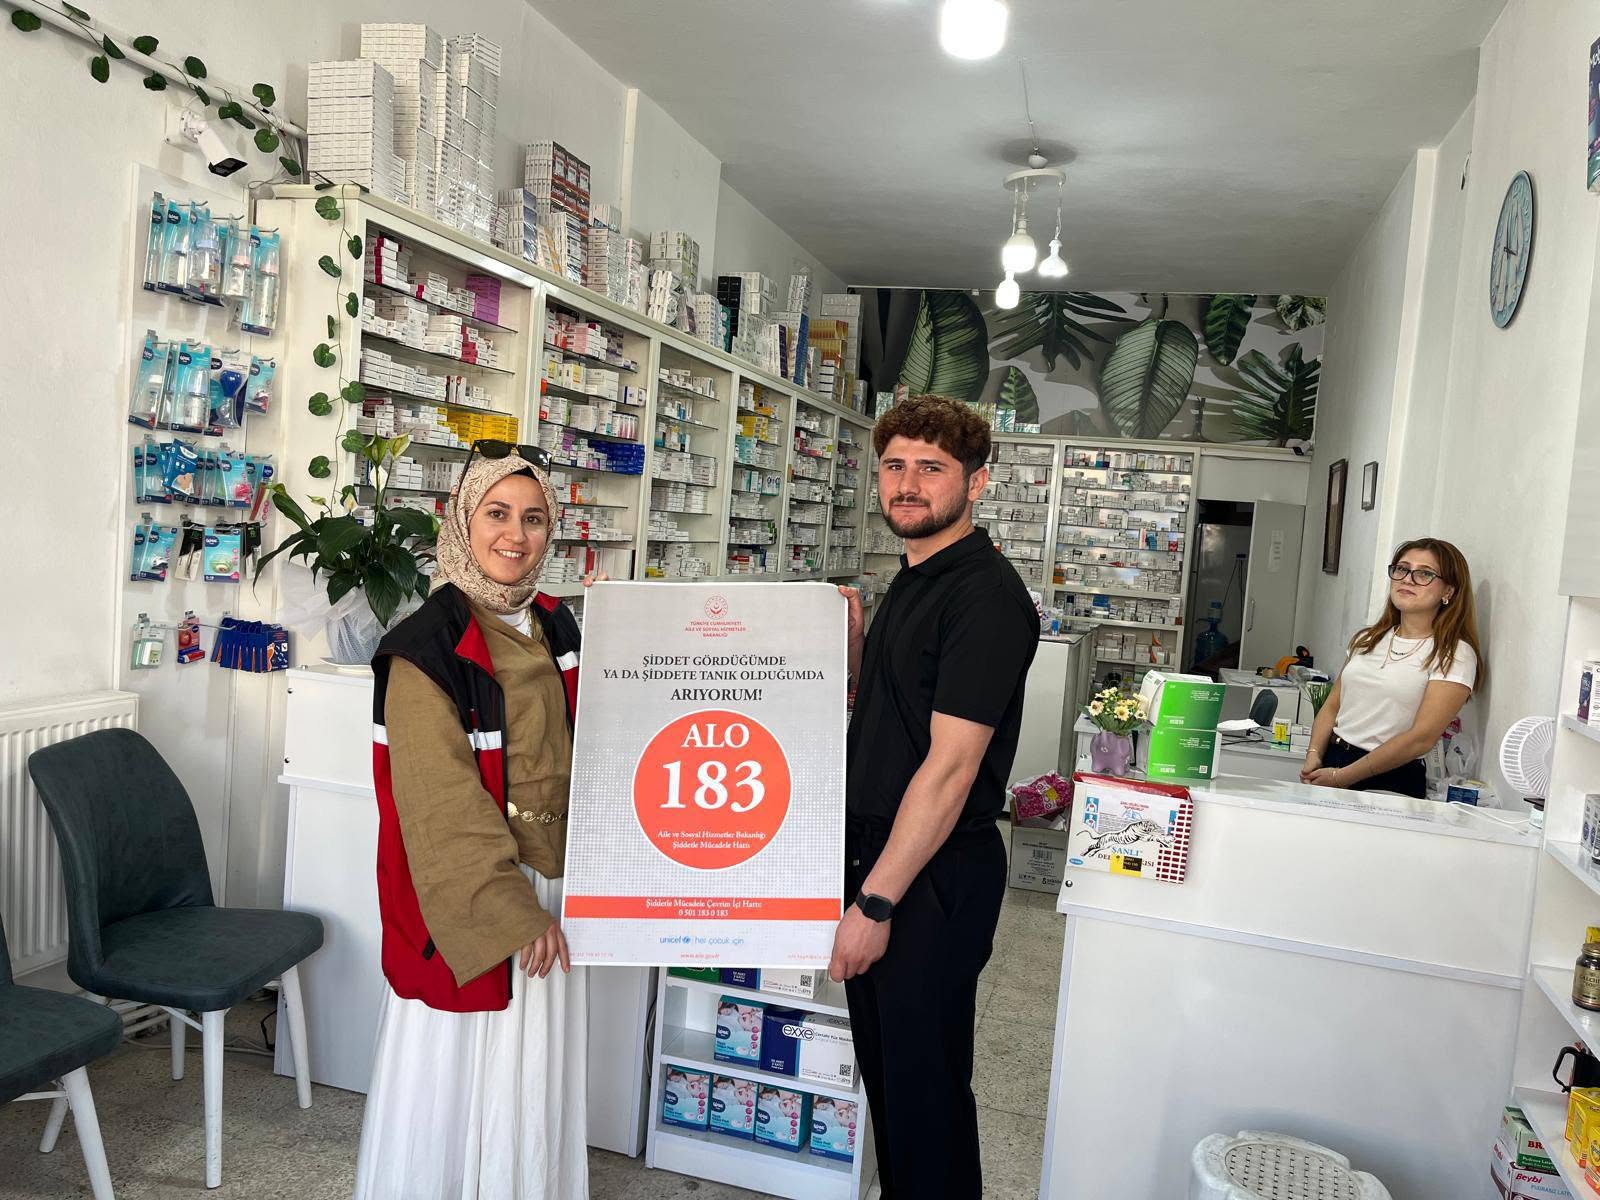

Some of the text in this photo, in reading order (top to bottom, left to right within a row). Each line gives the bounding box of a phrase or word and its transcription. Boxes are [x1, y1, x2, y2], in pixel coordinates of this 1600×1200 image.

[643, 654, 786, 667] ŞİDDET GÖRDÜĞÜMDE
[603, 668, 824, 682] YA DA ŞİDDETE TANIK OLDUĞUMDA
[670, 688, 762, 701] ARIYORUM!
[681, 723, 749, 748] ALO
[660, 760, 765, 813] 183
[736, 832, 766, 840] Bakanlığı
[672, 841, 697, 849] Şiddetle
[700, 841, 730, 849] Mücadele
[646, 898, 672, 908] Şiddetle
[674, 899, 705, 908] Mücadele
[707, 899, 730, 908] Çevrim
[732, 899, 740, 909] İçi
[660, 936, 681, 944] unicef
[783, 1026, 813, 1039] exxe
[1528, 1140, 1545, 1150] BR
[1515, 1173, 1543, 1183] Beybi
